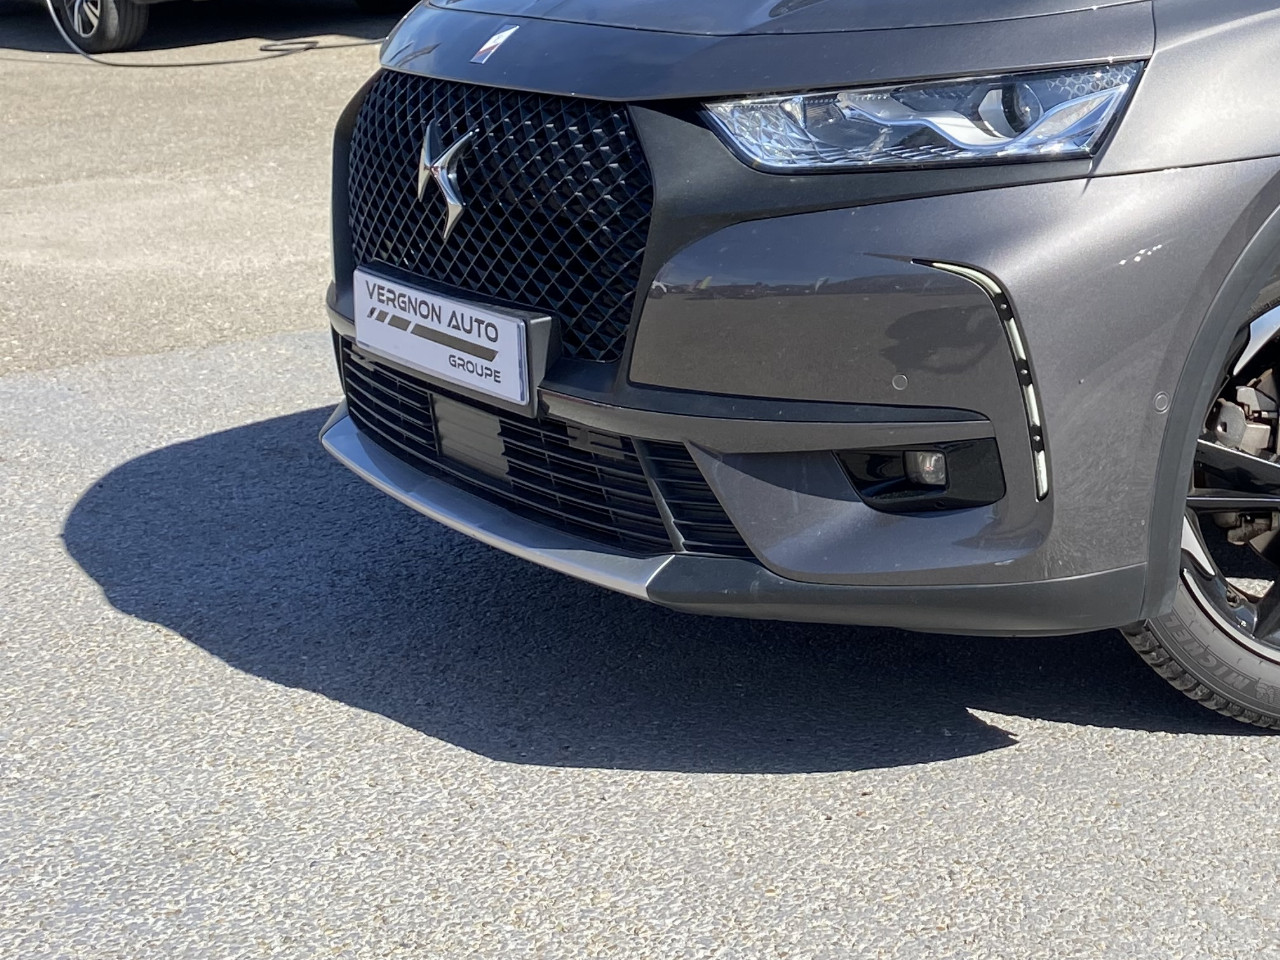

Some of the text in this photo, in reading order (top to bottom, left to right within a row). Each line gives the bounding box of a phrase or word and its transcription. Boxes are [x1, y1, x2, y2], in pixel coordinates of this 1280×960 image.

[365, 280, 499, 343] VERGNON AUTO
[448, 354, 502, 384] GROUPE
[1165, 613, 1251, 691] MICHEL
